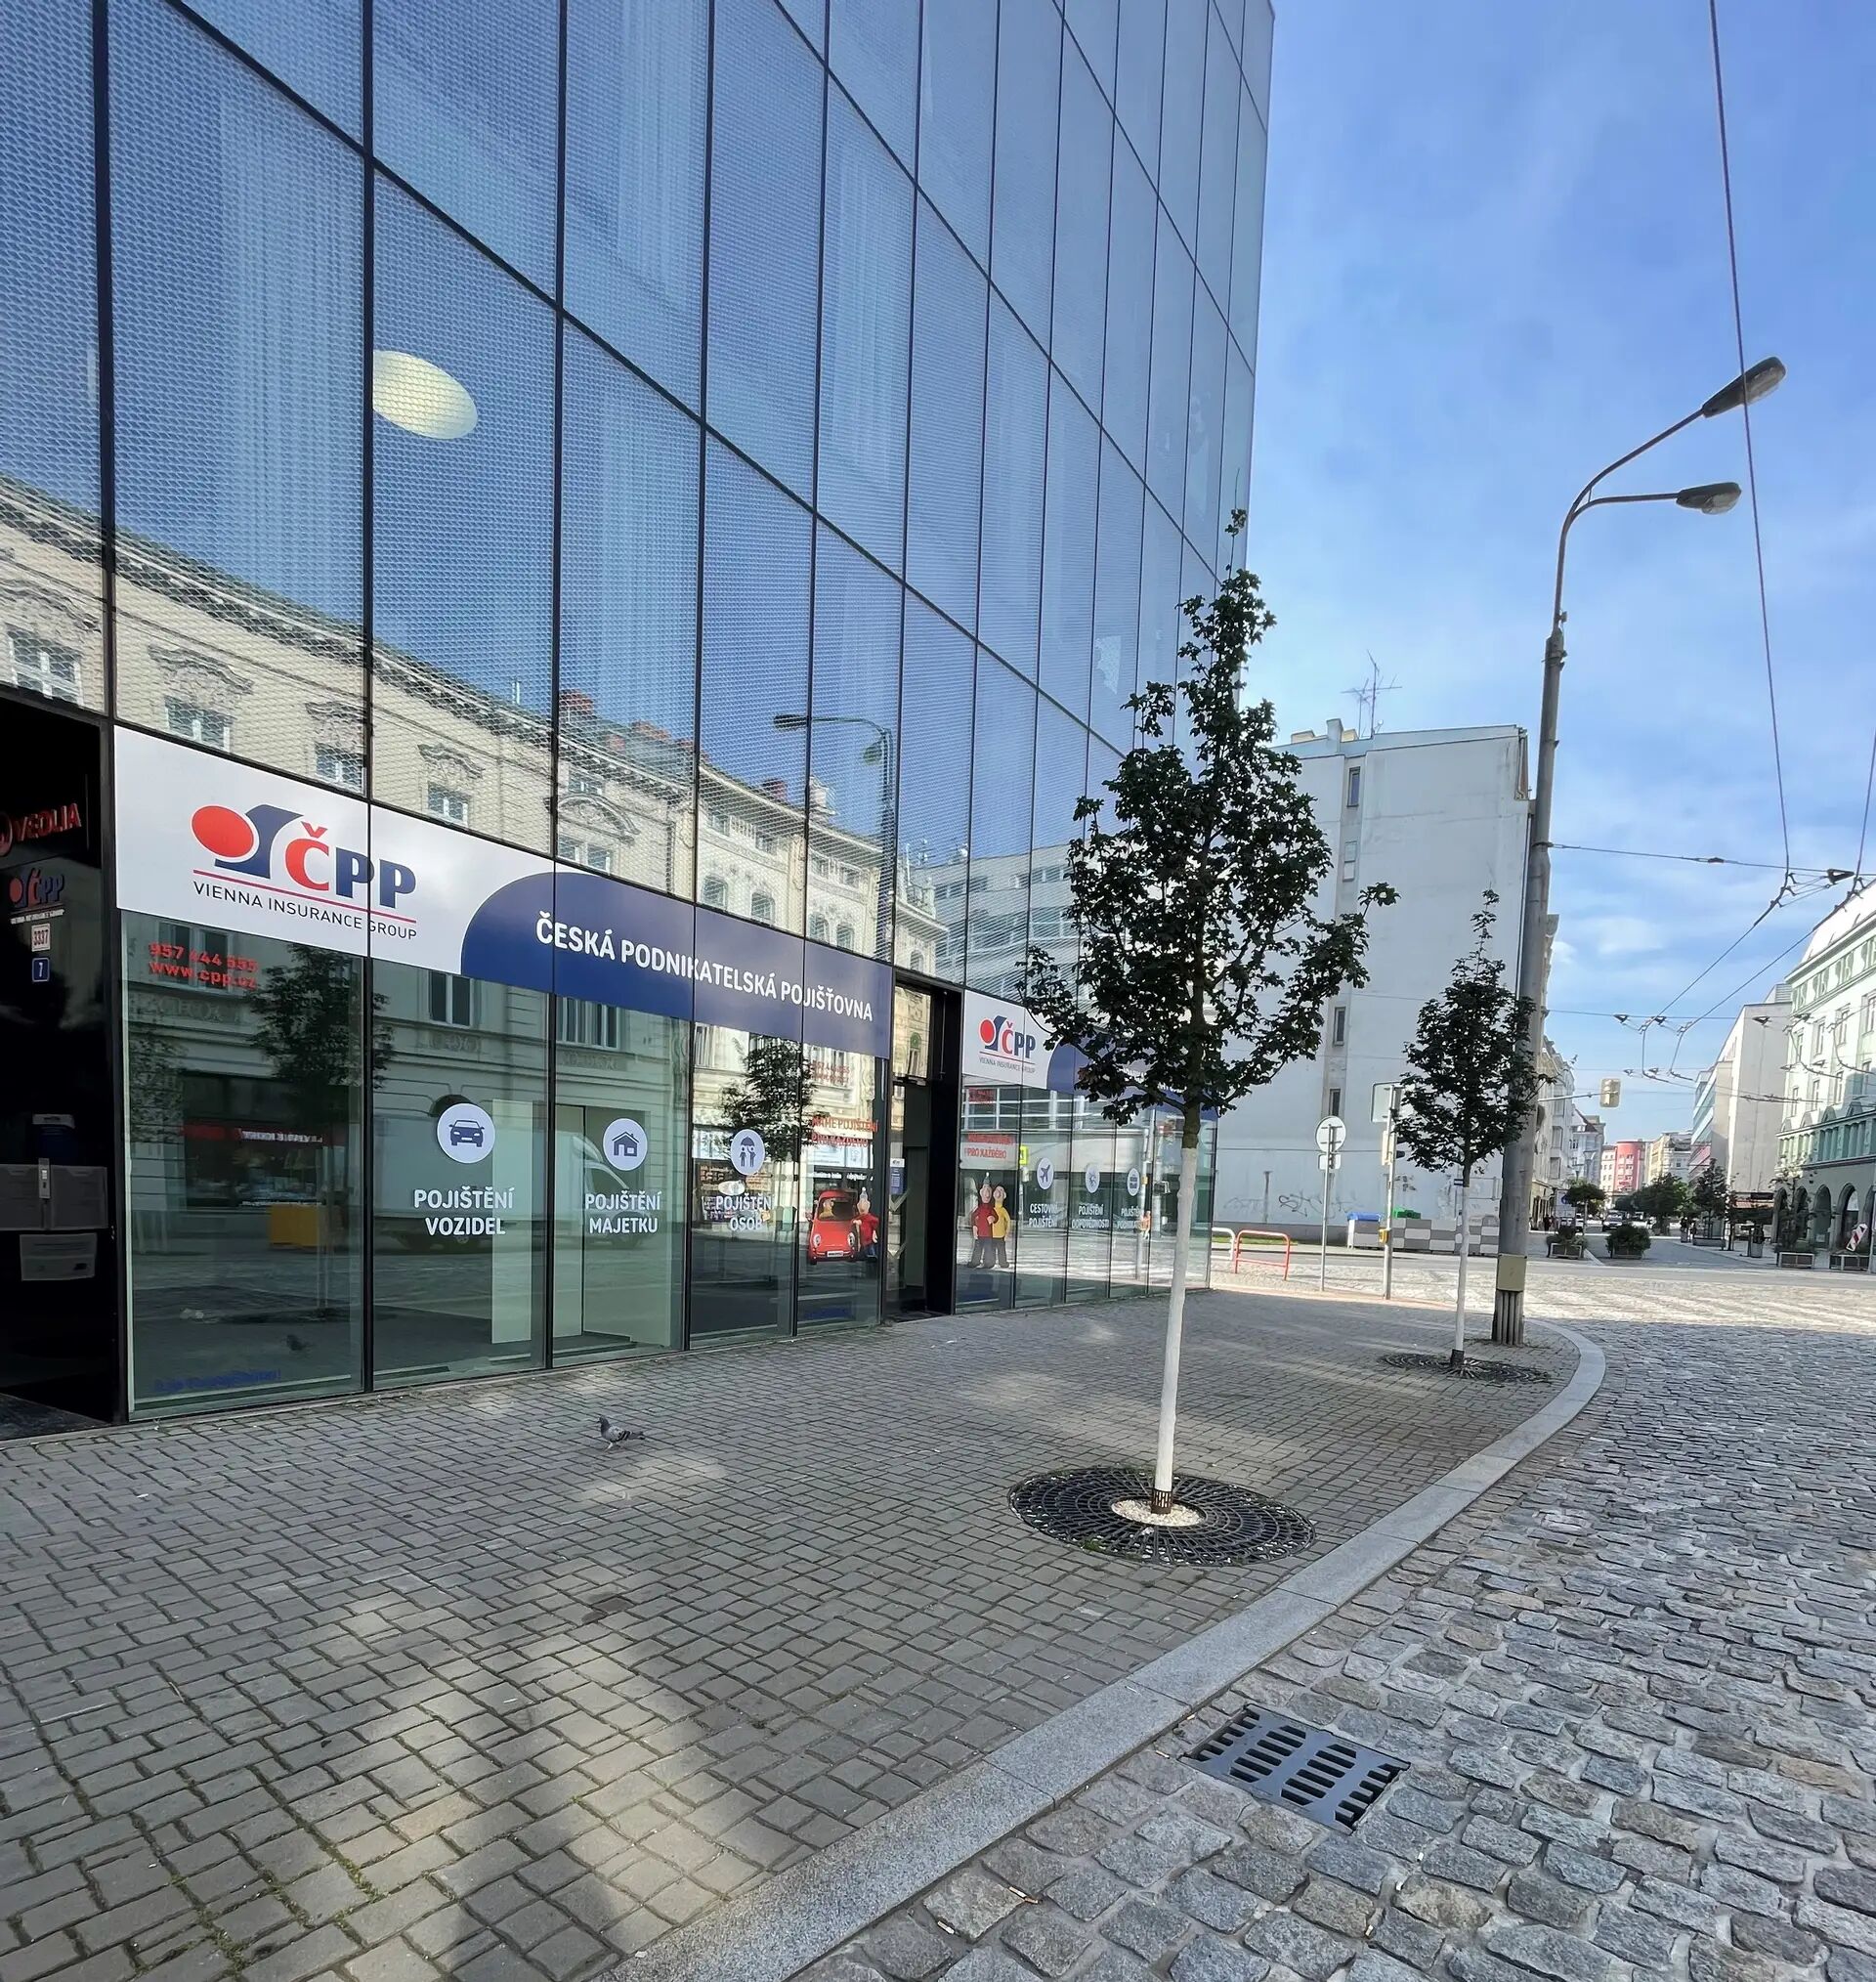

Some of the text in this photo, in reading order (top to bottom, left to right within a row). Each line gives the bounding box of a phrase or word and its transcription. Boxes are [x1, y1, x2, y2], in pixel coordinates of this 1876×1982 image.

[15, 802, 82, 842] VEOLIA
[285, 821, 416, 909] ČPP
[193, 881, 263, 908] VIENNA
[268, 897, 362, 929] INSURANCE
[33, 929, 49, 946] 3337
[149, 941, 185, 960] 957
[149, 961, 257, 991] www.cpp.cz
[535, 910, 874, 1022] ČESKÁ PODNIKATELSKÁ POJIŠŤOVNA
[1002, 1020, 1036, 1058] ČPP
[414, 1185, 514, 1210] POJIŠTĚNÍ
[585, 1189, 661, 1211] POJIŠTĚNÍ
[716, 1192, 777, 1212] POJIŠTĚN
[425, 1217, 505, 1236] VOZIDEL
[589, 1218, 658, 1234] MAJETKU
[730, 1216, 764, 1232] OSOB
